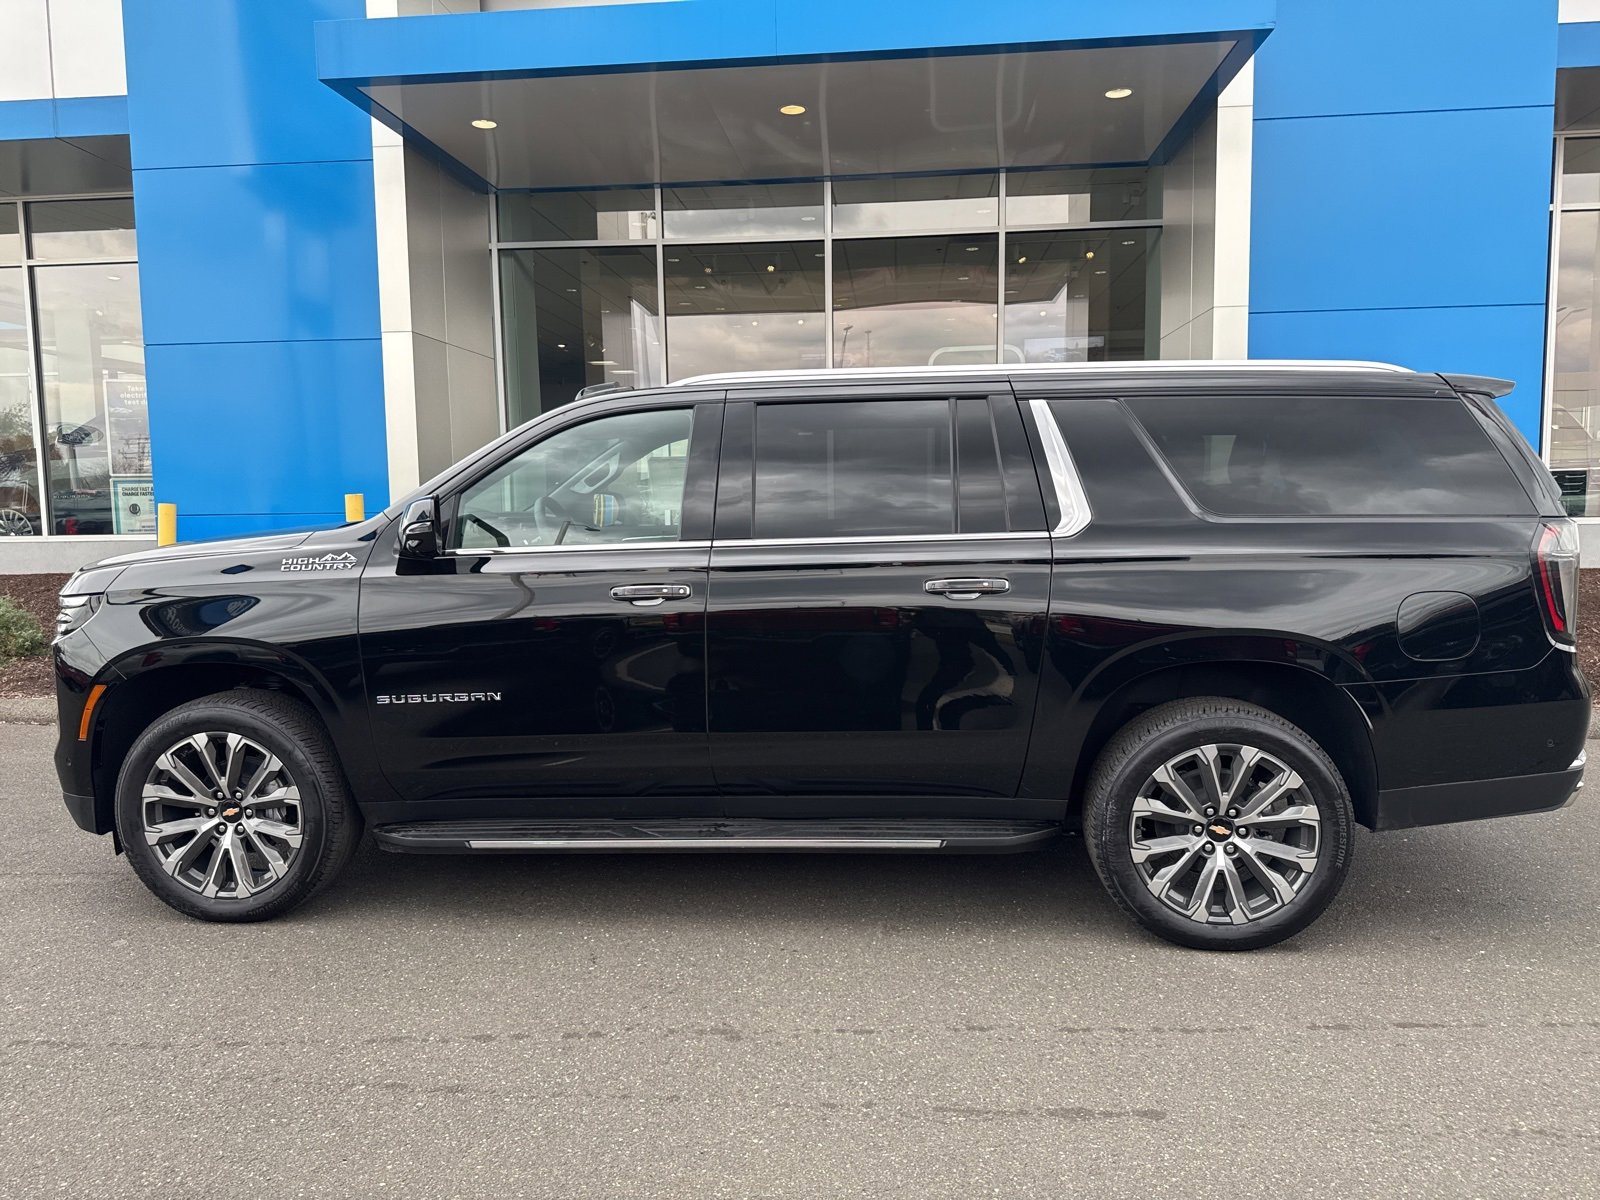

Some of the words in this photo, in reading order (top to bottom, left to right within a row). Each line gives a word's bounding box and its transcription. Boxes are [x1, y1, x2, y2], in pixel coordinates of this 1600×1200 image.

[281, 557, 320, 565] HIGH
[280, 562, 356, 572] COUNTRY
[376, 692, 502, 705] SUBURBAN
[1333, 798, 1347, 870] BRIDGESTONE
